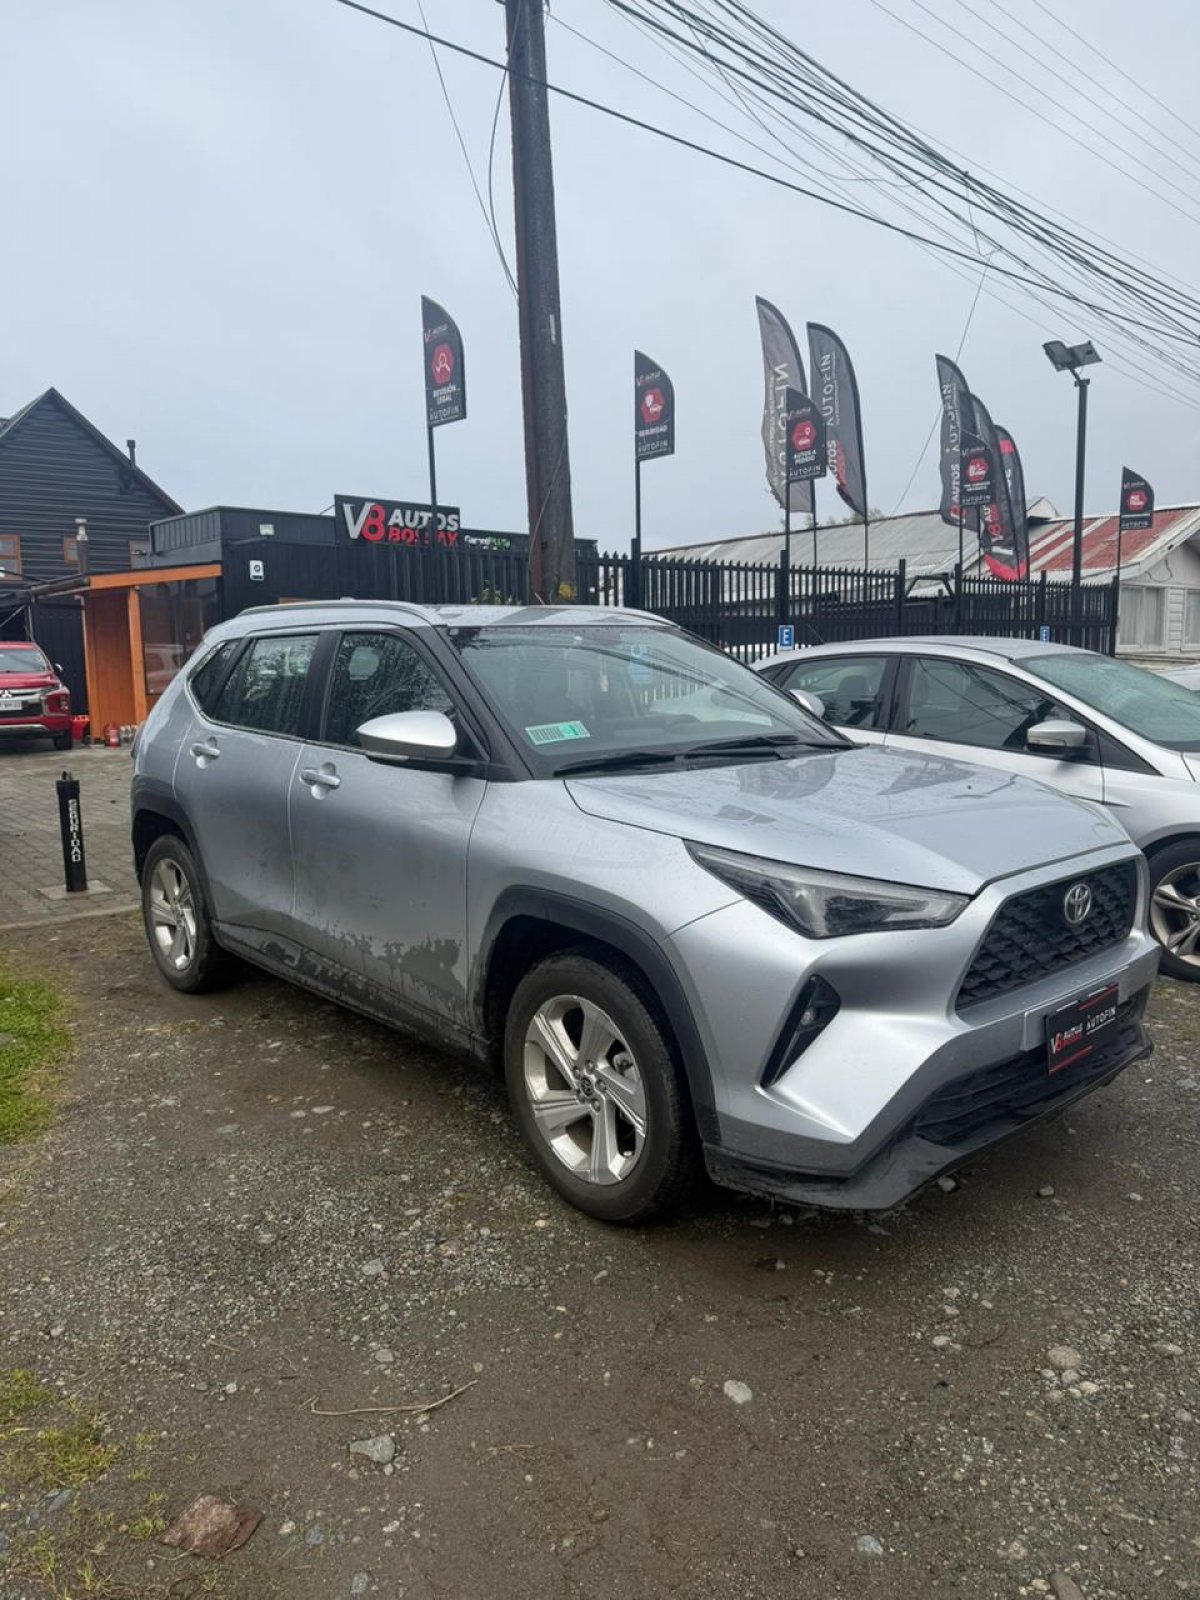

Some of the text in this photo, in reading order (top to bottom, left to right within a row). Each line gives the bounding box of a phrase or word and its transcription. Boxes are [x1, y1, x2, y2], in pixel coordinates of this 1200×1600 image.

[342, 502, 386, 541] V8
[388, 509, 459, 531] AUTOS
[783, 629, 790, 644] E
